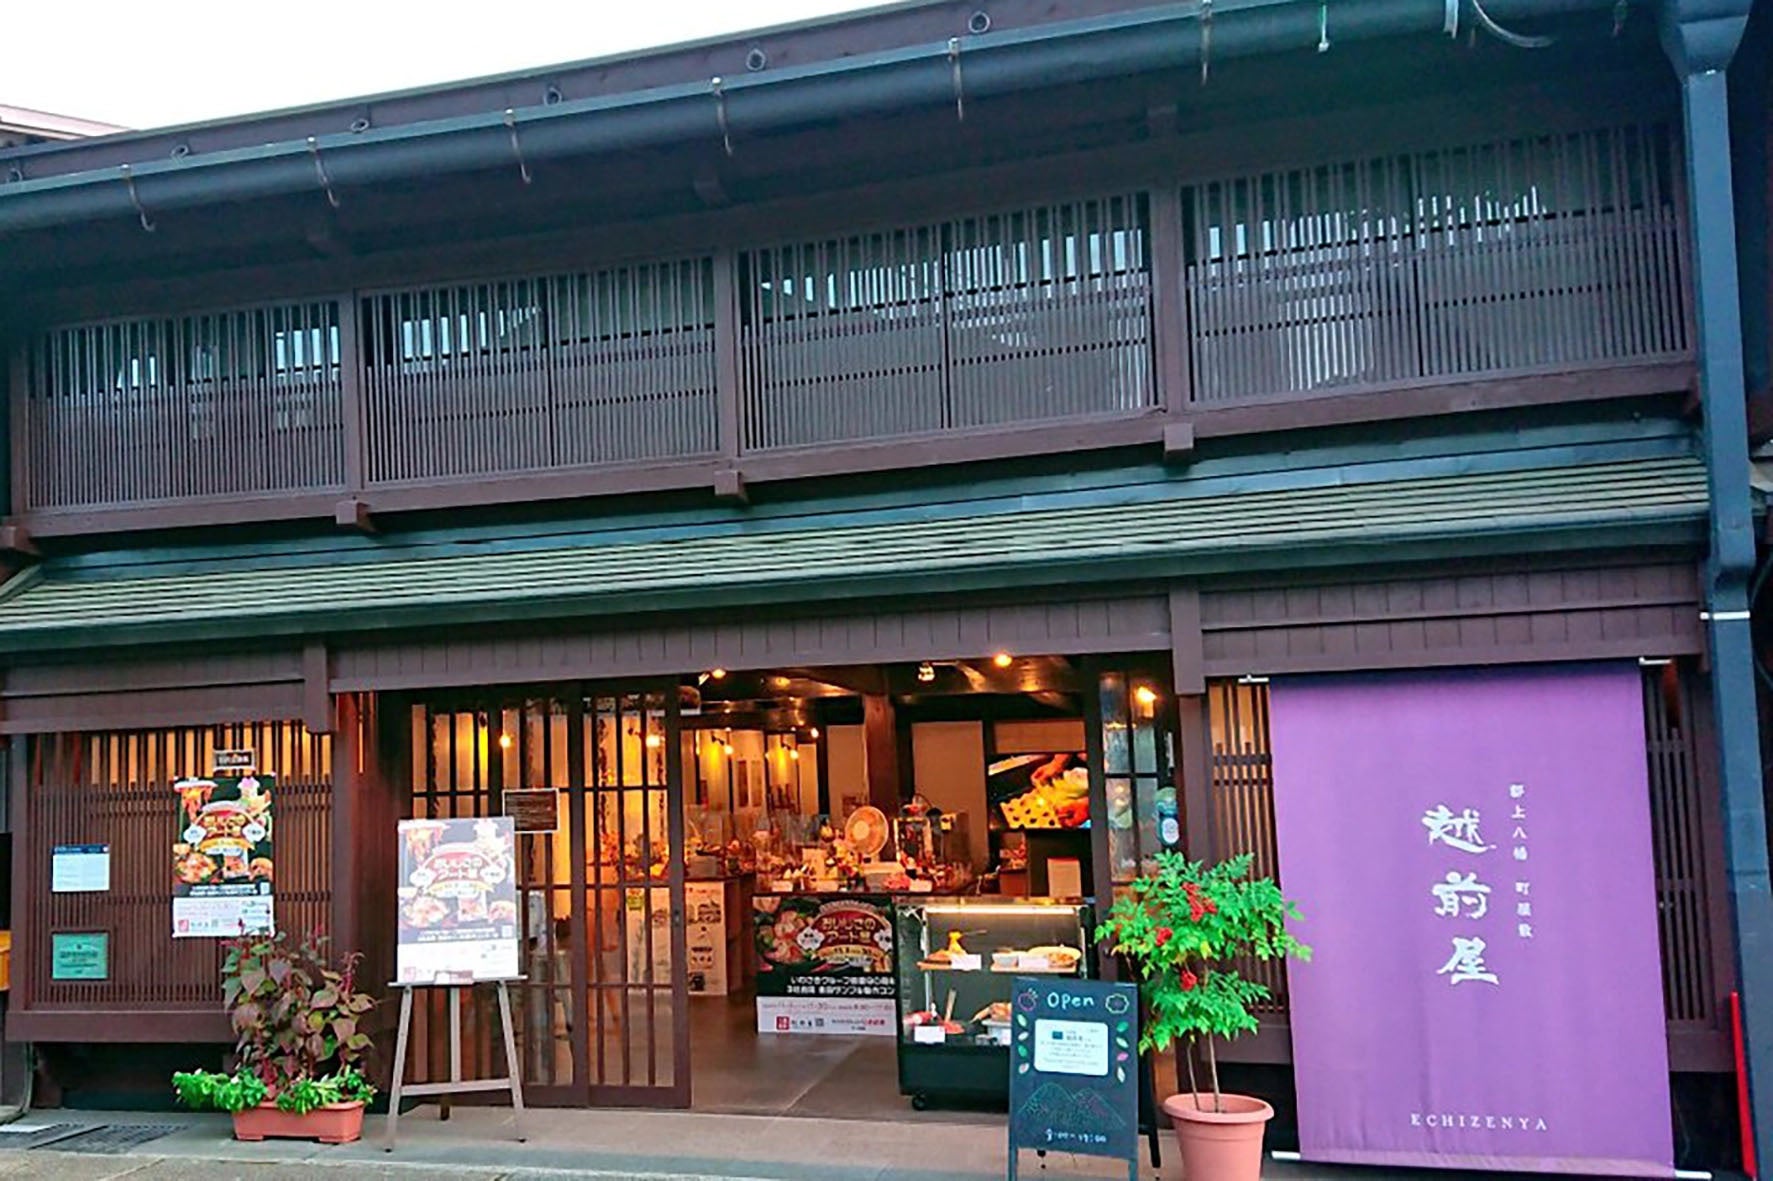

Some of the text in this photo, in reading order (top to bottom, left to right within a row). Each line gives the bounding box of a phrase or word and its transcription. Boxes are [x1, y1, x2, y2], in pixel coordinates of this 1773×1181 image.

[1421, 804, 1500, 985] 越前屋
[1047, 991, 1095, 1010] Open
[1410, 1113, 1548, 1131] ECHIZENYA
